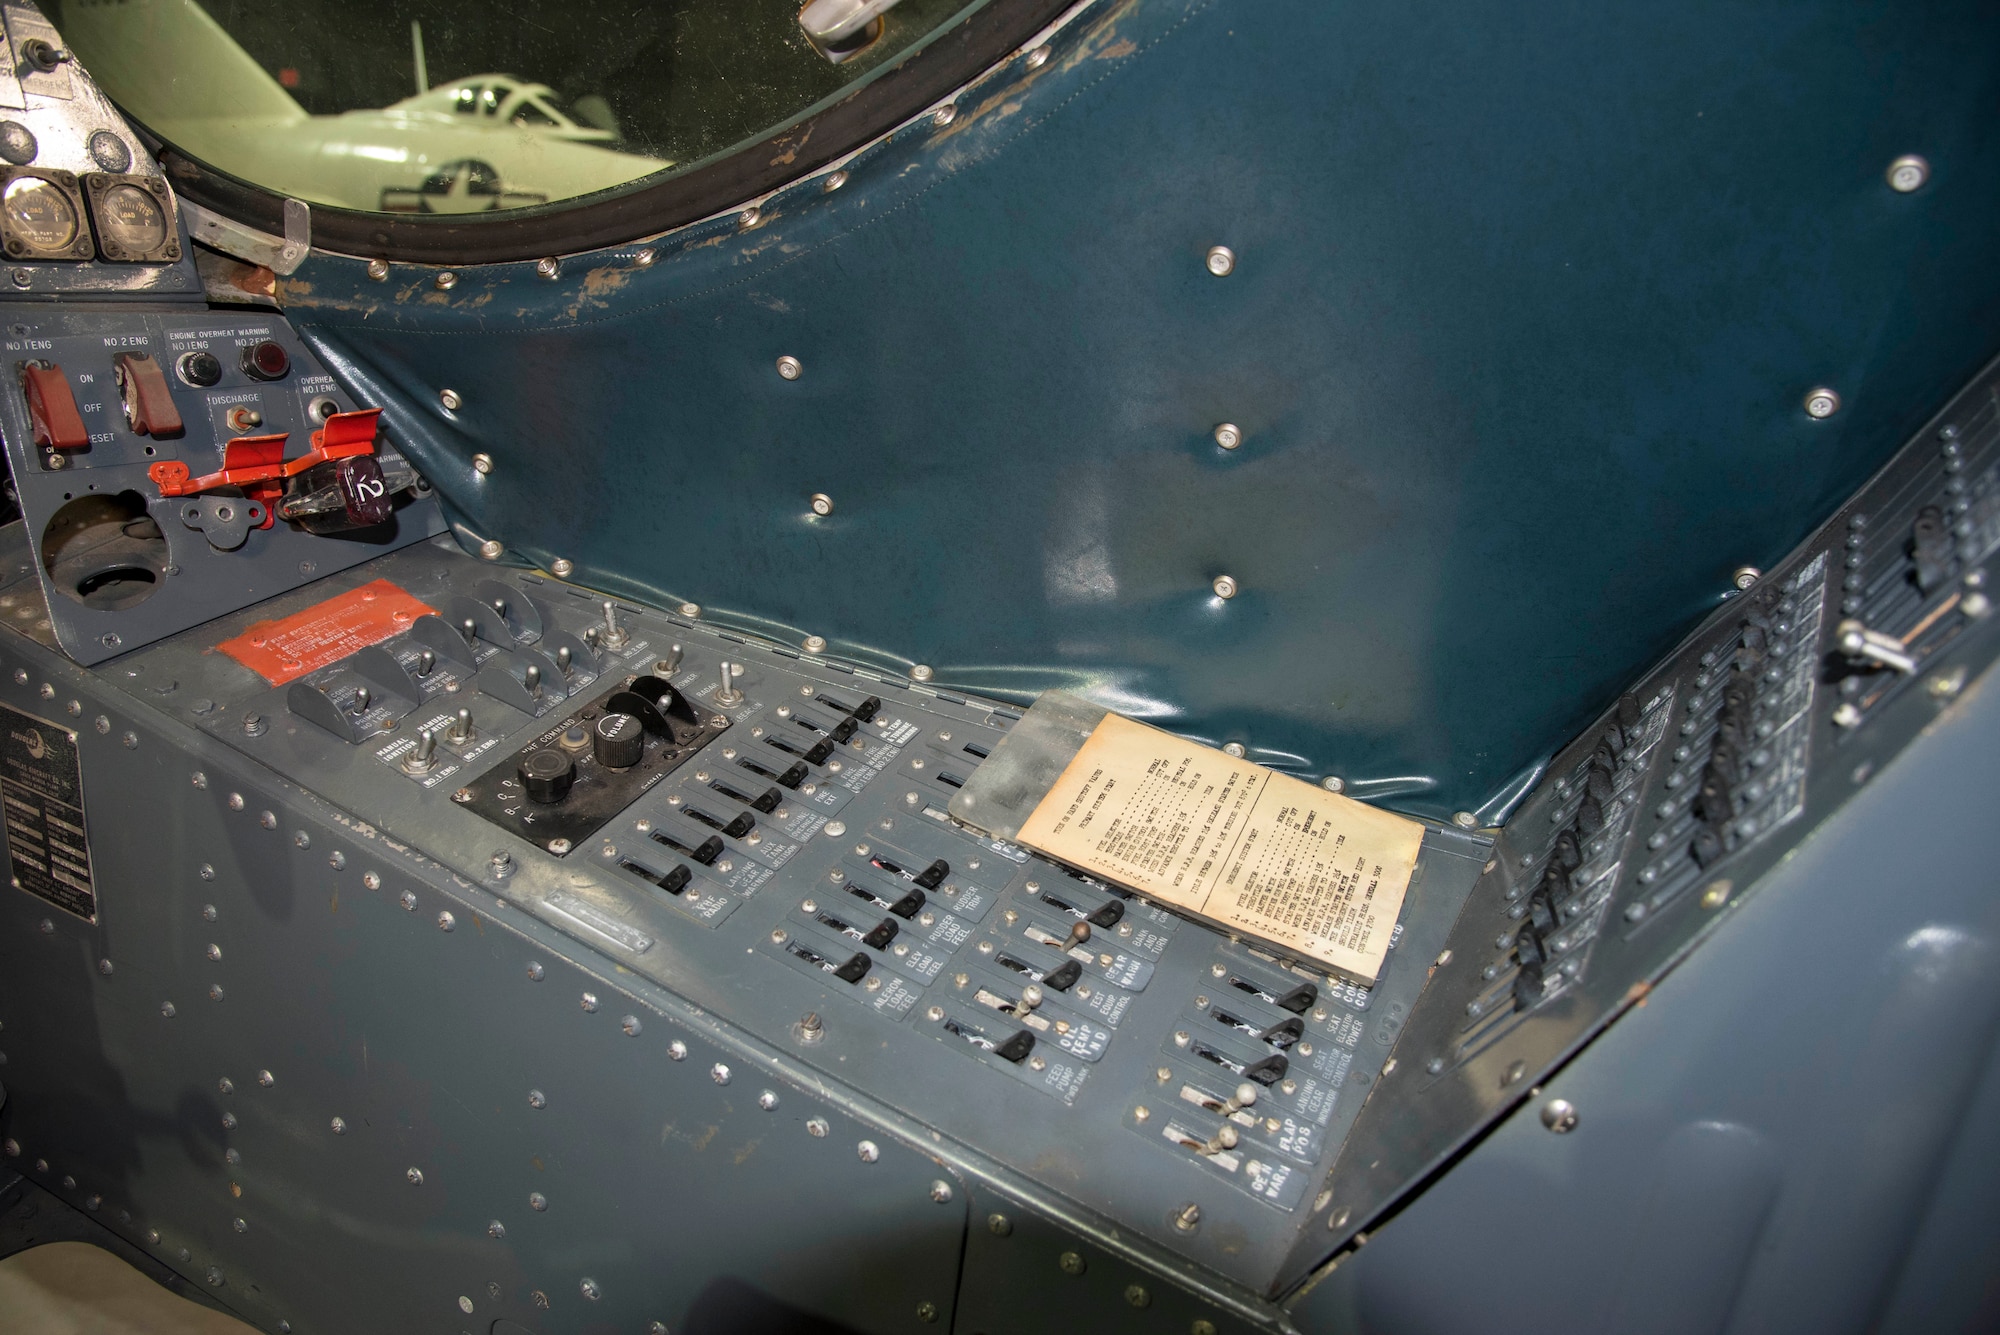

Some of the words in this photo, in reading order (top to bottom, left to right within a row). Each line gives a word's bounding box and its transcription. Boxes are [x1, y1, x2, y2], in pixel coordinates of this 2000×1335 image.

[130, 337, 148, 345] ENG
[170, 331, 196, 339] ENGINE
[200, 330, 234, 338] OVERHEAT
[238, 328, 269, 336] WARNING
[32, 341, 52, 349] ENG
[192, 341, 209, 349] ENG
[80, 374, 94, 383] ON
[321, 384, 336, 392] ENG
[84, 404, 101, 413] OFF
[211, 394, 259, 404] DISCHARGE
[336, 634, 360, 645] NOTE
[632, 653, 656, 670] GROUND
[420, 671, 449, 689] PRIMARY
[696, 683, 719, 698] RADAR
[355, 706, 385, 726] PRIMARY
[736, 702, 762, 720] BEACON
[417, 713, 448, 732] MANUAL
[540, 719, 576, 743] COMMAND
[607, 715, 630, 738] VOLUME
[887, 718, 903, 731] TEMP
[890, 721, 912, 740] TURBINE
[896, 725, 918, 745] WARNING
[376, 737, 409, 757] MANUAL
[384, 740, 417, 762] IGNITION
[863, 744, 880, 758] FIRE
[867, 742, 893, 766] WARNING
[886, 745, 900, 757] ENG
[839, 765, 857, 780] FIRE
[843, 764, 870, 788] WARNING
[862, 767, 877, 780] ENG
[813, 789, 830, 803] FIRE
[823, 793, 838, 805] EXT
[1077, 810, 1095, 829] PRIMARY
[1090, 791, 1108, 810] SYSTEM
[1102, 778, 1116, 792] START
[524, 816, 535, 824] A
[783, 809, 810, 832] ENGINE
[790, 812, 818, 838] OVERHEAT
[797, 814, 829, 842] WARNING
[759, 840, 777, 855] AUX
[766, 842, 786, 860] TANK
[771, 843, 798, 868] JETTISON
[1225, 861, 1242, 885] EMERGENCY
[1237, 842, 1252, 861] SYSTEM
[1246, 827, 1259, 842] START
[1354, 856, 1366, 871] LIGHT
[724, 860, 756, 888] LANDING
[737, 868, 760, 888] GEAR
[740, 867, 775, 897] WARNING
[952, 884, 978, 912] RUDDER
[1343, 883, 1356, 901] SYSTEM
[702, 896, 728, 918] RADIO
[964, 893, 984, 912] TRIM
[1346, 920, 1364, 950] HYDRAULIC
[1364, 878, 1378, 901] GENERAL
[1372, 864, 1383, 878] 3000
[1332, 901, 1350, 930] EMERGENCY
[928, 913, 955, 942] RUDDER
[941, 921, 961, 942] LOAD
[950, 926, 971, 946] FEEL
[1131, 927, 1150, 947] BANK
[1328, 930, 1338, 942] THE
[1356, 928, 1371, 954] CONTROL
[1365, 914, 1376, 929] 2700
[1142, 932, 1158, 949] AND
[1150, 935, 1168, 955] TURN
[904, 950, 923, 968] ELEV
[914, 954, 935, 974] LOAD
[925, 958, 944, 977] FEEL
[1104, 953, 1129, 981] GEAR
[1119, 958, 1141, 987] WARN
[871, 976, 903, 1009] AILERON
[886, 986, 909, 1009] LOAD
[895, 991, 918, 1013] FEEL
[1088, 990, 1106, 1009] TEST
[1106, 992, 1130, 1025] CONTROL
[1326, 1013, 1341, 1035] SEAT
[1335, 1012, 1353, 1043] ELEVATOR
[1345, 1018, 1363, 1047] POWER
[1058, 1023, 1078, 1048] OIL
[1070, 1023, 1093, 1056] TEMP
[1312, 1049, 1327, 1071] SEAT
[1321, 1047, 1340, 1080] ELEVATOR
[1330, 1050, 1352, 1087] CONTROL
[1043, 1061, 1066, 1086] FEED
[1053, 1065, 1077, 1092] PUMP
[1072, 1066, 1090, 1086] TANK
[1293, 1077, 1316, 1115] LANDING
[1307, 1087, 1324, 1113] GEAR
[1316, 1087, 1337, 1125] INDICATOR
[1278, 1116, 1298, 1152] FLAP
[1291, 1124, 1311, 1156] POS
[1264, 1162, 1291, 1200] WARN
